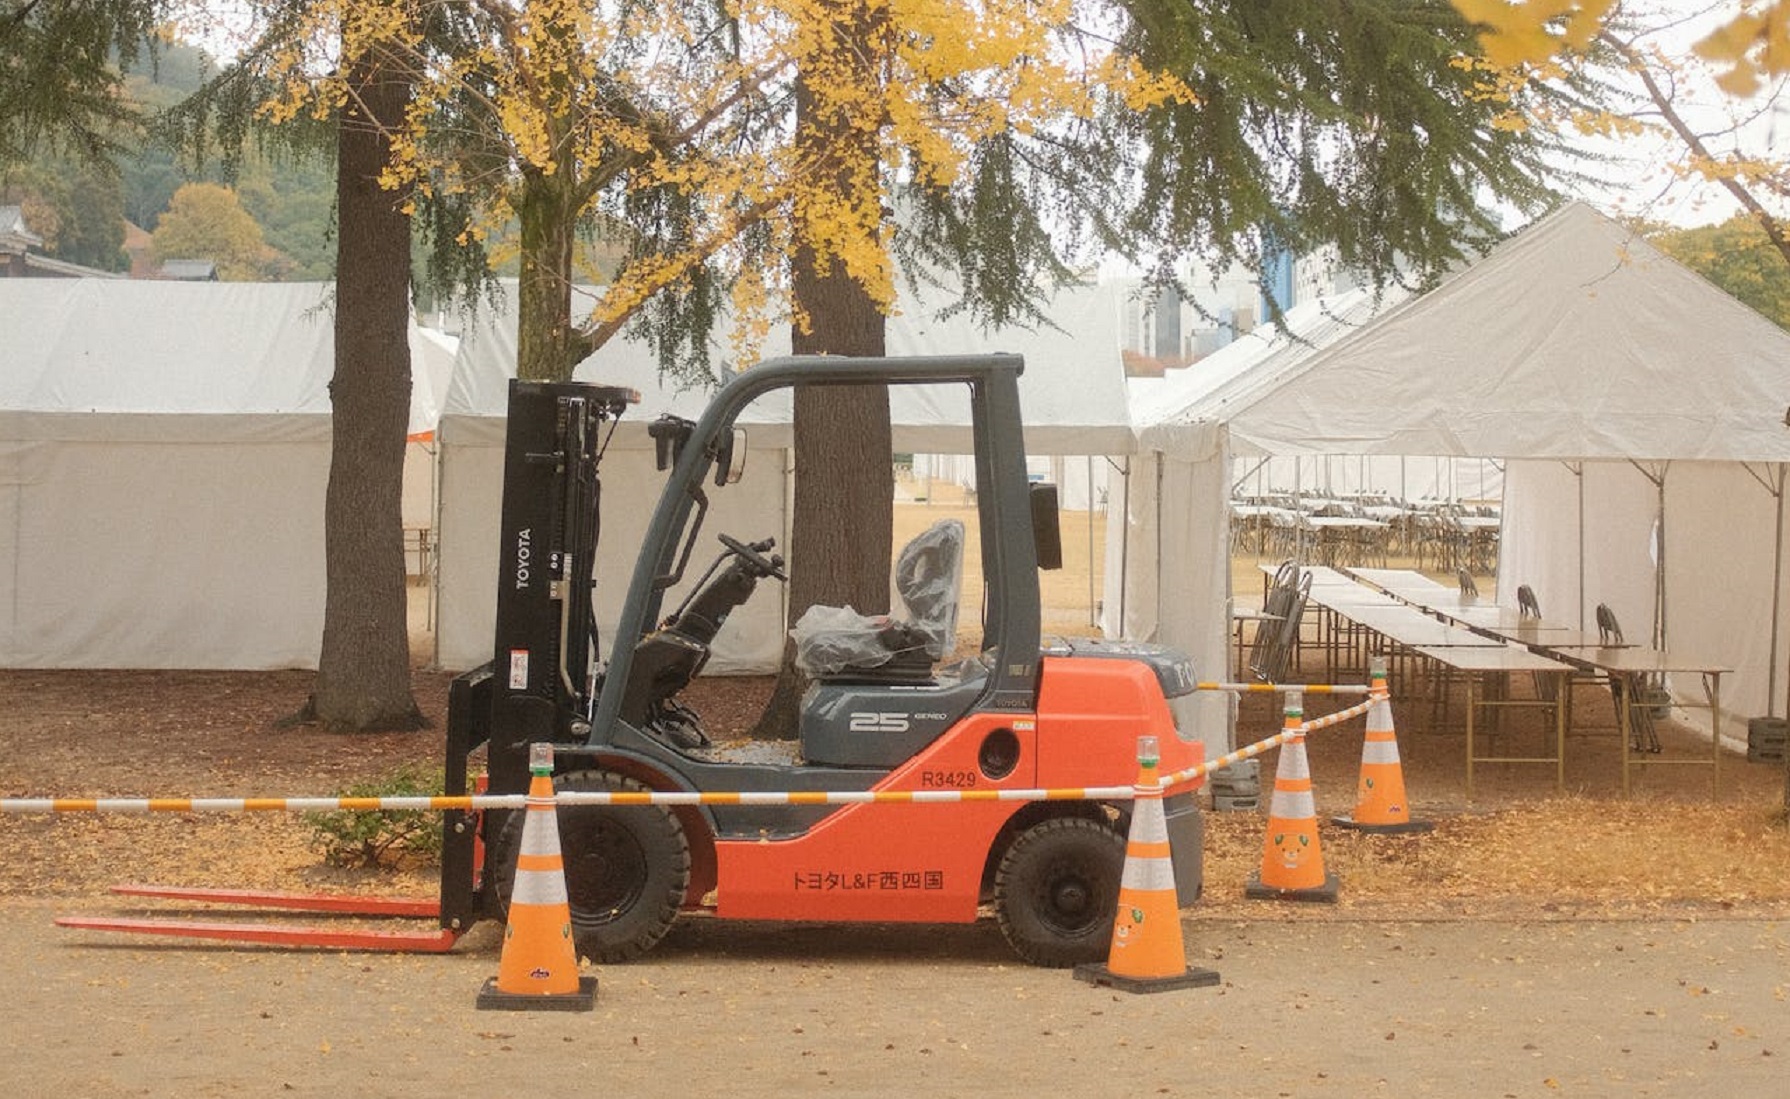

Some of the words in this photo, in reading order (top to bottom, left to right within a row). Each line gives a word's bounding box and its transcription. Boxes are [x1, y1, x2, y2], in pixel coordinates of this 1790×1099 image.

[516, 528, 531, 590] TOYOTA
[1173, 660, 1196, 688] TO
[849, 712, 910, 732] 25
[921, 770, 976, 788] R3429
[794, 870, 944, 891] トヨタL&F西四国
